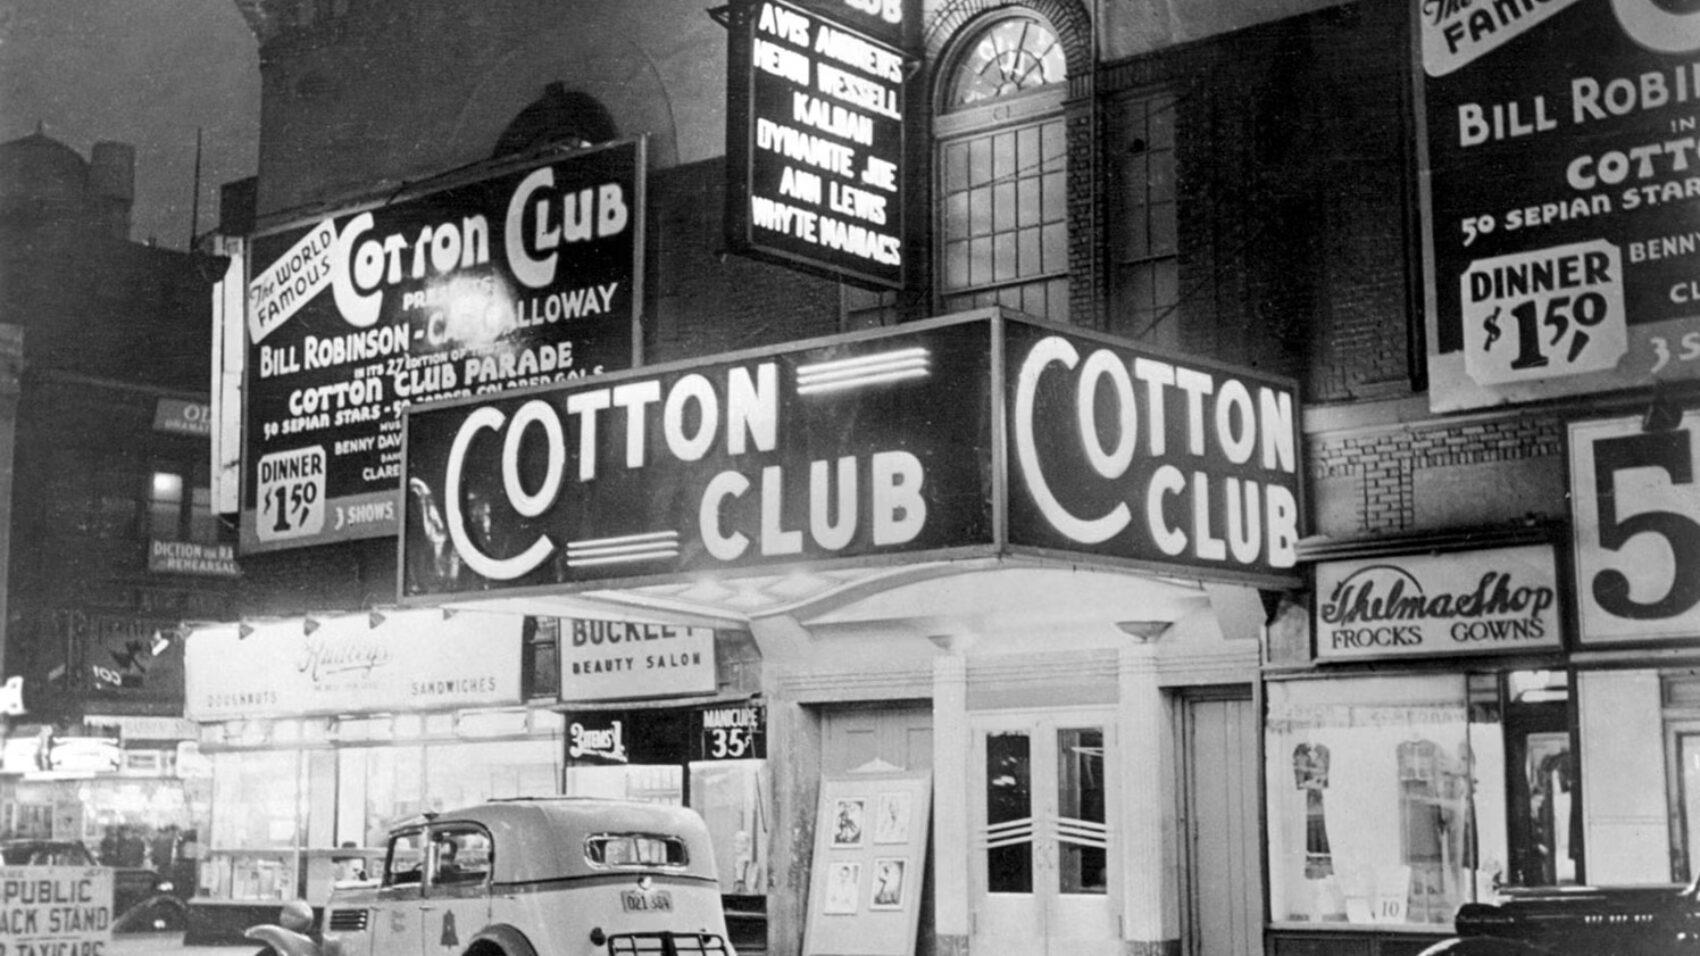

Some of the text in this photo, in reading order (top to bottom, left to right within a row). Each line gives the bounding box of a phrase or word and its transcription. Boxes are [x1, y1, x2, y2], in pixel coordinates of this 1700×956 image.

[758, 2, 810, 47] AVIS
[815, 25, 902, 83] ANDREWS
[817, 61, 902, 121] WESSELL
[1458, 95, 1557, 147] BILL
[1671, 116, 1695, 133] IN
[757, 117, 897, 192] DYNAMITE JOE
[779, 166, 886, 225] ANN LEWIS
[1461, 214, 1495, 247] 50
[1505, 194, 1611, 231] SEPIAN
[505, 166, 628, 288] CLUB
[752, 195, 901, 265] WHYTE MANIACS
[1629, 231, 1700, 263] BENN
[276, 230, 331, 286] WORLD
[1470, 251, 1613, 303] DINNER
[258, 255, 330, 328] FAMOUS
[261, 345, 300, 378] BILL
[304, 323, 409, 370] ROBINSON
[1650, 336, 1670, 373] 3
[289, 341, 573, 416] COTTON CLUB PARADE
[264, 422, 279, 441] 50
[282, 413, 330, 434] SEPIAN
[335, 404, 380, 426] STARS
[334, 436, 375, 456] BENNY
[1016, 336, 1297, 543] COTTON
[262, 453, 322, 484] DINNER
[445, 361, 777, 580] COTTON
[347, 501, 394, 524] SHOWS
[698, 451, 927, 560] CLUB
[1148, 464, 1300, 567] CLUB
[1592, 429, 1700, 619] 5
[1332, 617, 1544, 649] FROCKS GOWNS
[411, 677, 496, 696] SANDWICHES
[573, 653, 700, 675] BEAUTY SALON
[703, 709, 758, 728] MANICURE
[5, 880, 91, 904] PUBLIC
[49, 907, 108, 933] STAND
